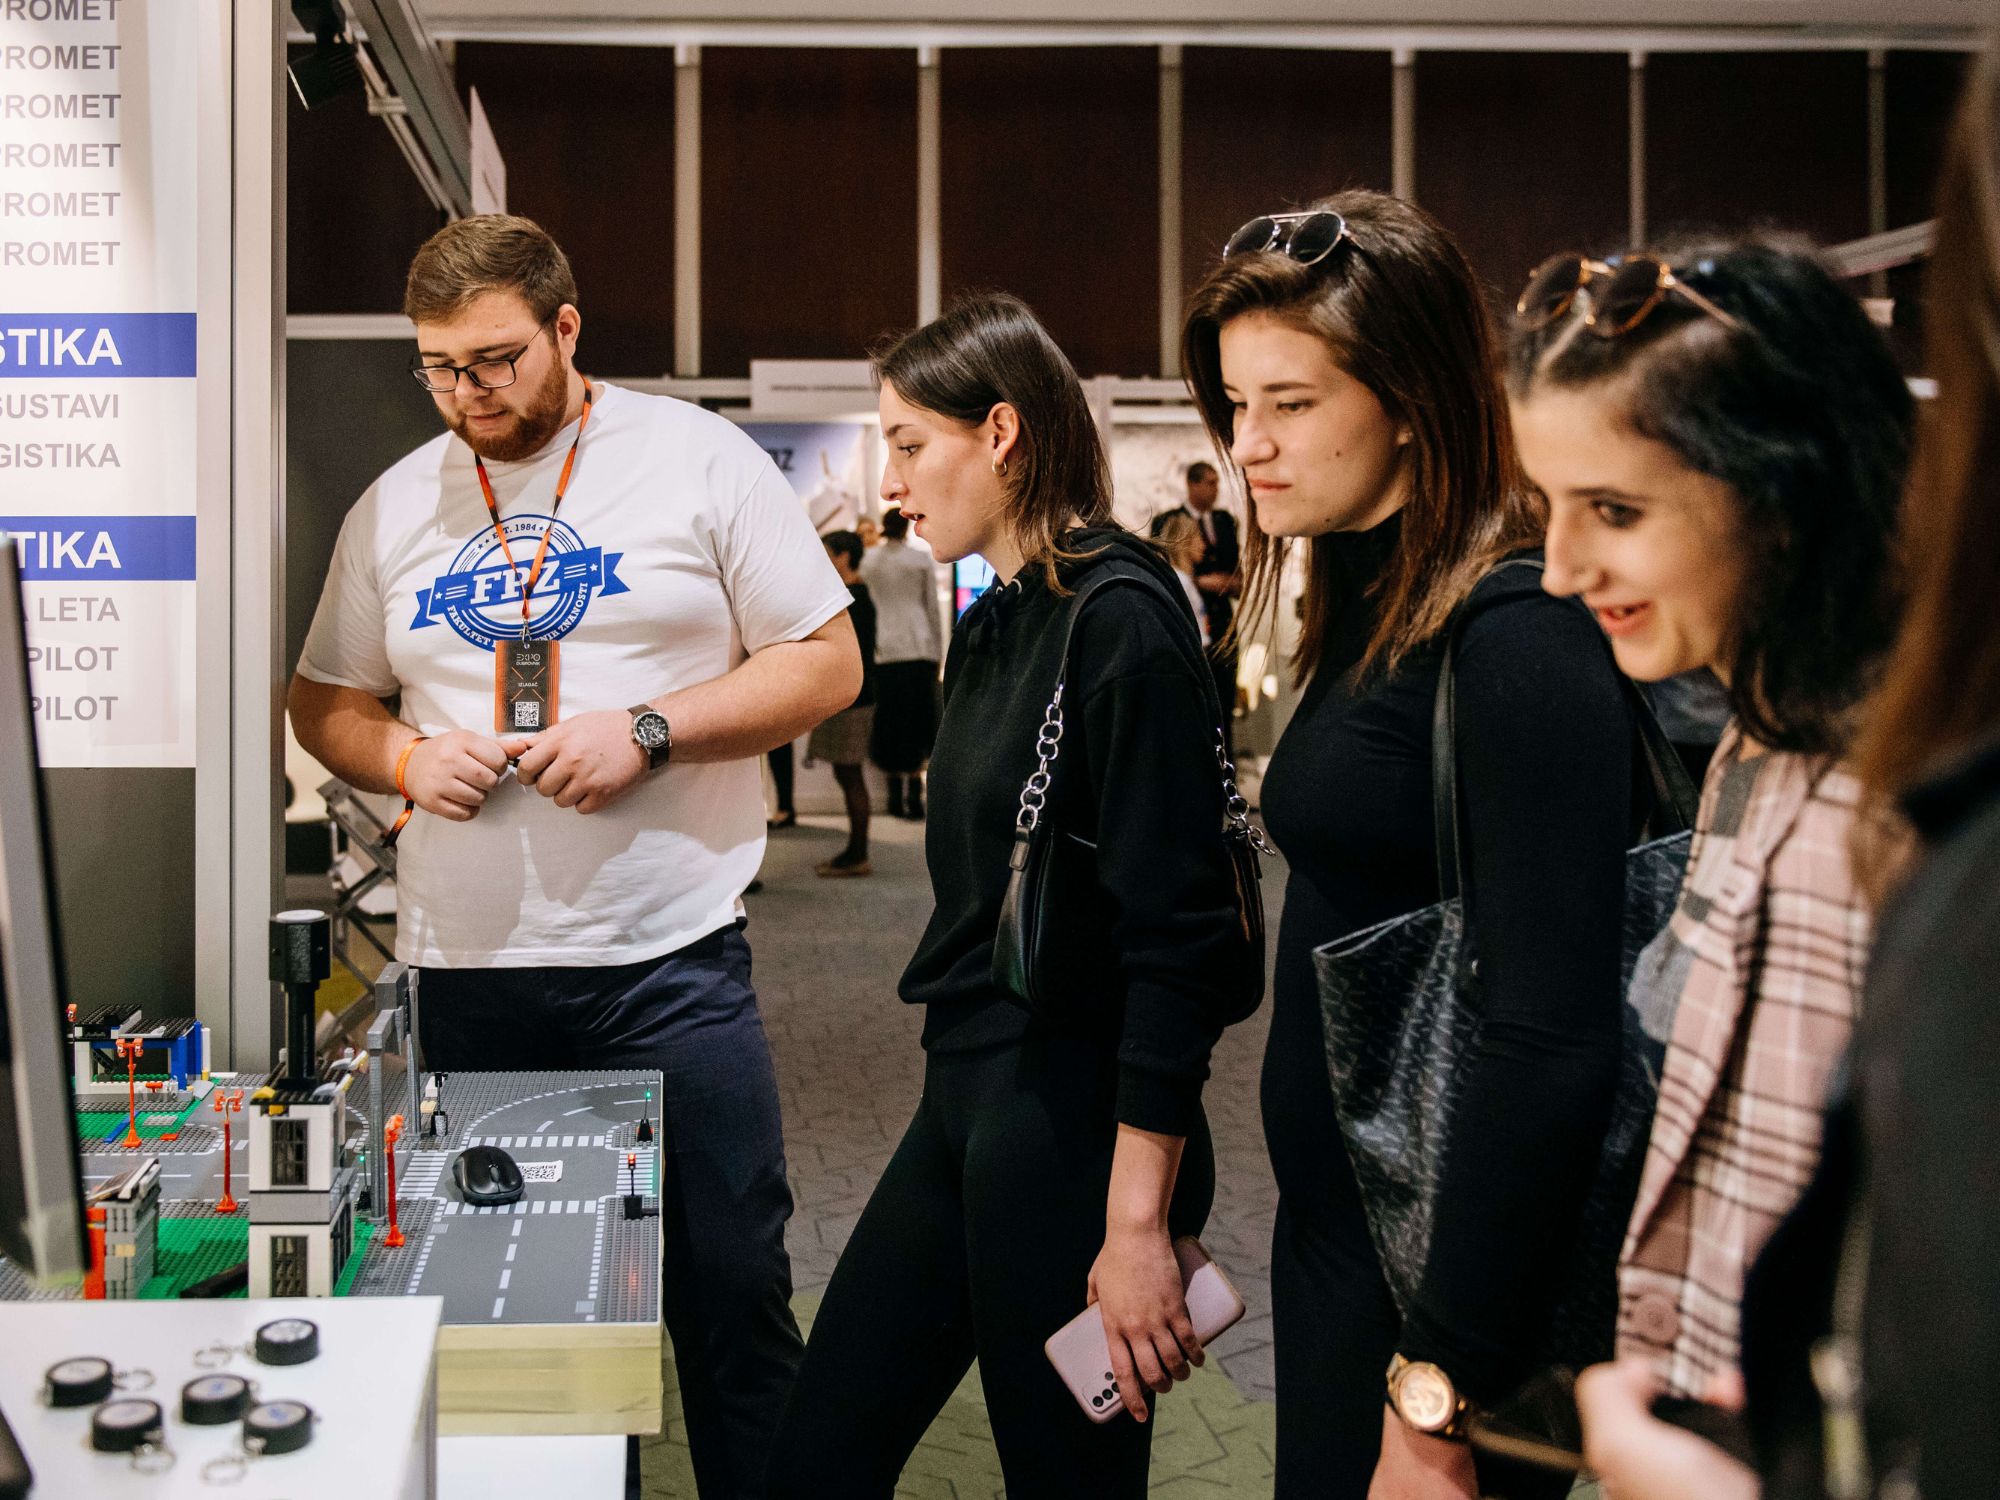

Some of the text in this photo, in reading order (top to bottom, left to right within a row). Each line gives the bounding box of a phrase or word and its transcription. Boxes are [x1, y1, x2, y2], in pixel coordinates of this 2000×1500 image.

[0, 0, 120, 20] ROMET
[0, 45, 121, 70] ROMET
[0, 94, 121, 119] ROMET
[0, 143, 121, 168] ROMET
[0, 192, 120, 217] ROMET
[0, 241, 120, 266] ROMET
[0, 328, 122, 366] TIKA
[0, 394, 118, 419] USTAVI
[492, 523, 537, 540] ET. 1984
[470, 560, 560, 605] FPZ
[39, 597, 120, 622] LETA
[447, 582, 588, 648] FAKULTET ZNANOSTI
